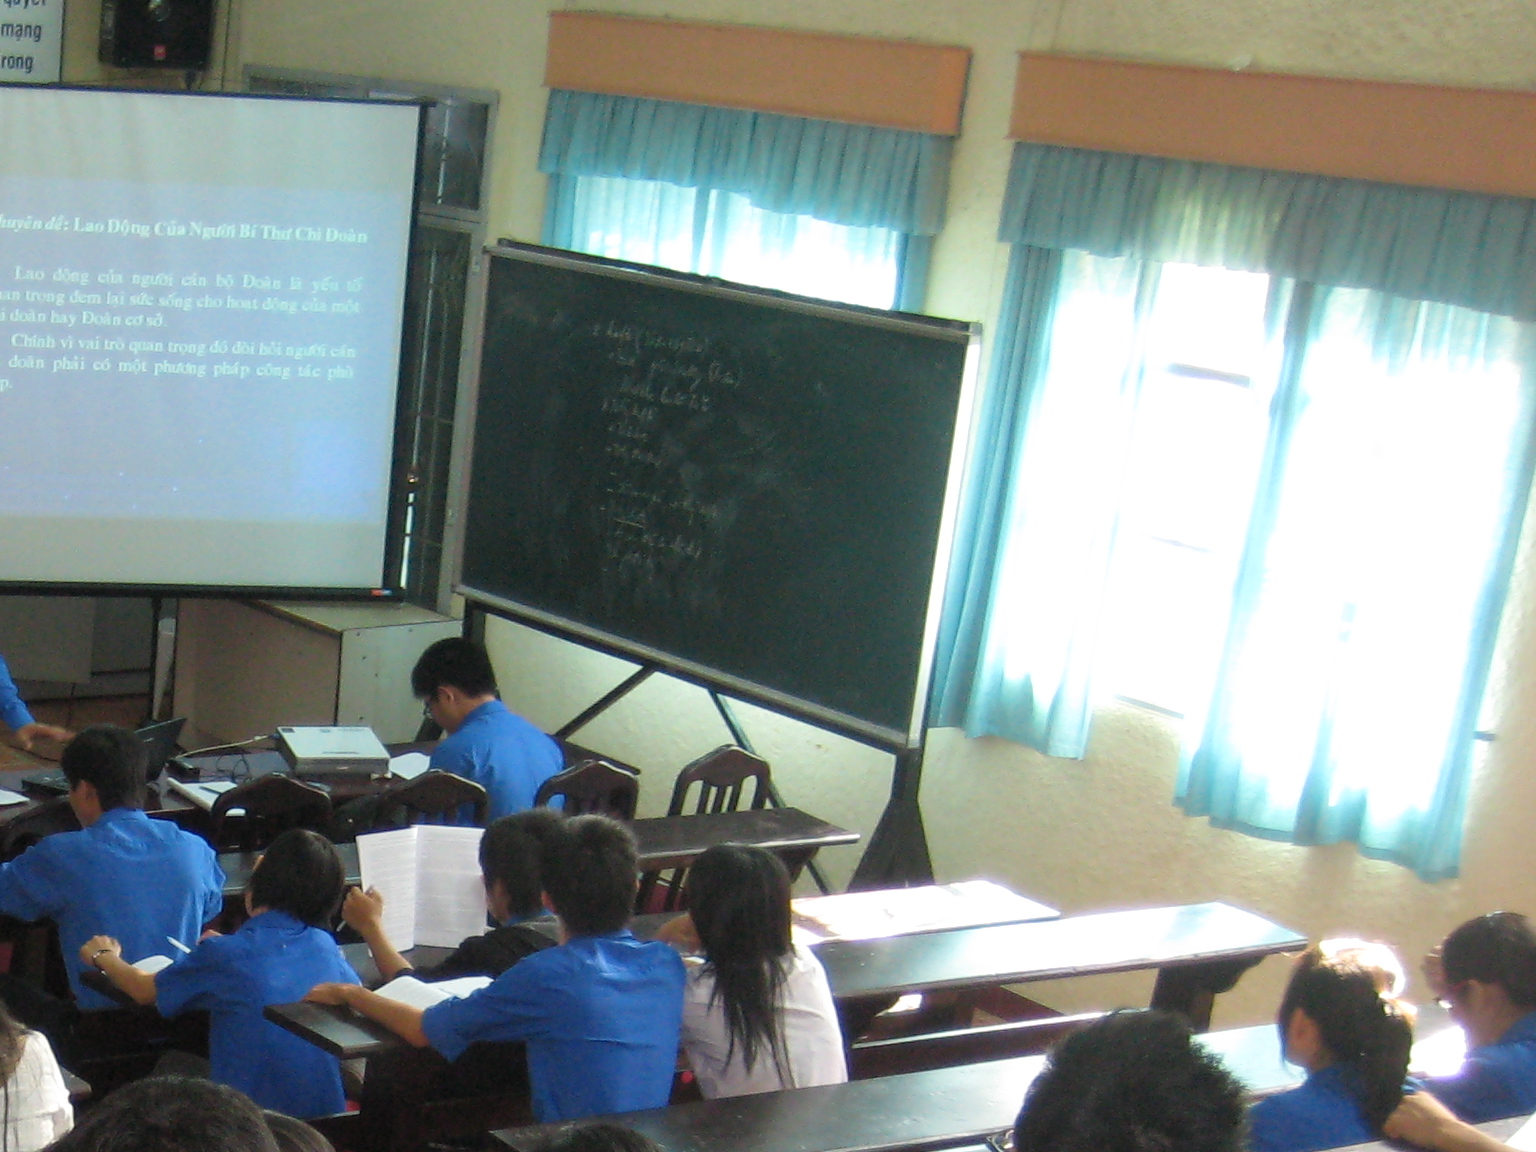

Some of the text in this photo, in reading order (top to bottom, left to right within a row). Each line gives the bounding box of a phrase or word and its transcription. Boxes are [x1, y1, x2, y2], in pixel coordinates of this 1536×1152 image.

[1, 22, 42, 42] mạng
[73, 216, 105, 232] Lao
[295, 226, 322, 241] Chi
[14, 265, 45, 281] Lao
[50, 309, 76, 328] hay
[78, 335, 102, 351] vai
[129, 340, 163, 355] quan
[93, 357, 112, 372] có
